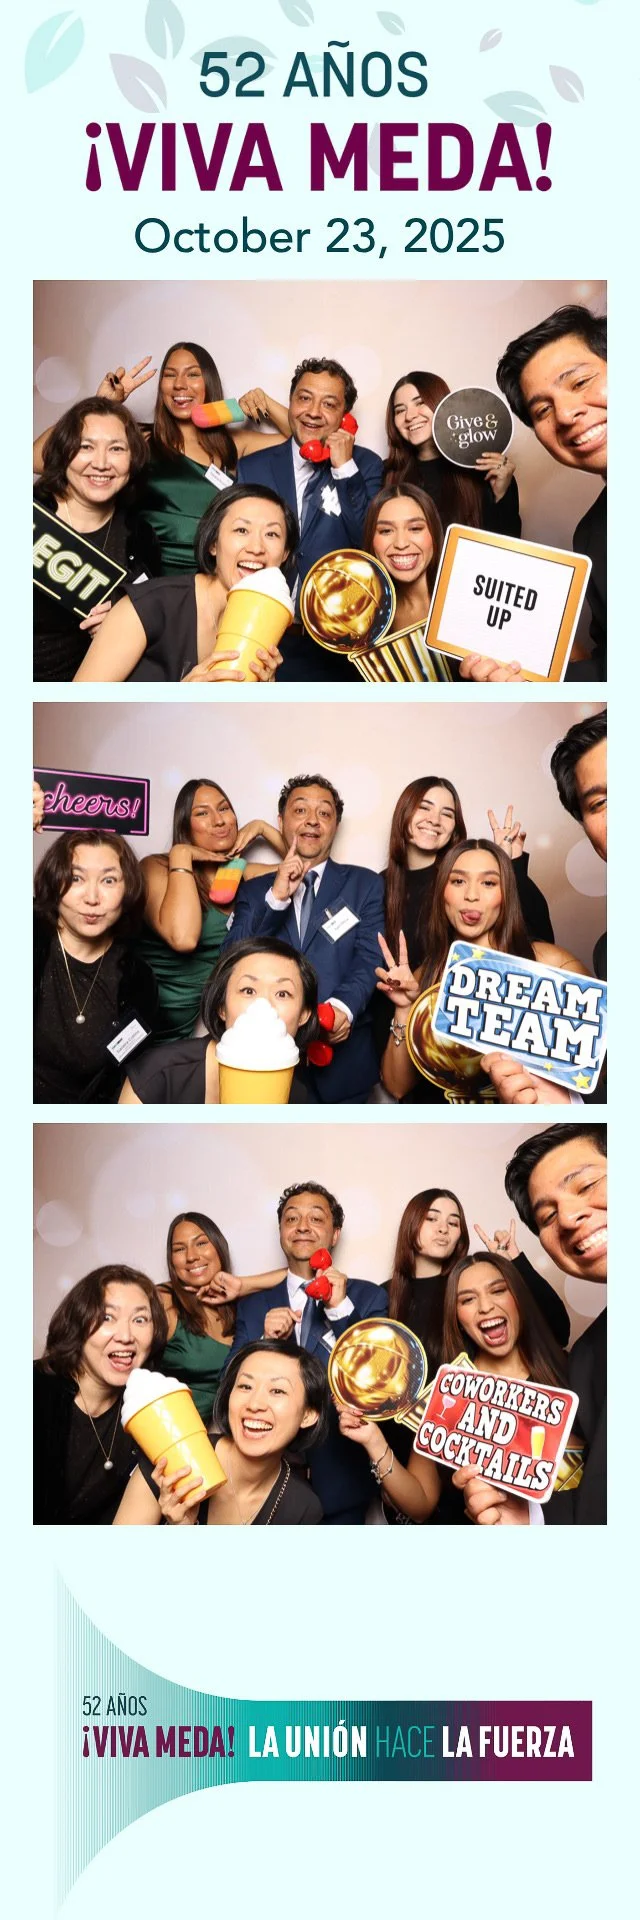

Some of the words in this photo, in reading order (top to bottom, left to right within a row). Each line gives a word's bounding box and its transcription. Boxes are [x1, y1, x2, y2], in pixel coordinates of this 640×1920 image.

[446, 414, 484, 430] Give
[485, 413, 498, 429] &
[458, 428, 498, 449] glow
[33, 525, 110, 600] EGIT
[473, 574, 538, 611] SUITED
[486, 604, 512, 630] UP
[43, 781, 141, 818] cheers!
[449, 965, 603, 1023] DREAM
[446, 995, 600, 1069] TEAM
[439, 1372, 565, 1426] COWORKERS
[456, 1401, 517, 1446] AND
[418, 1421, 554, 1491] COCKTAILS
